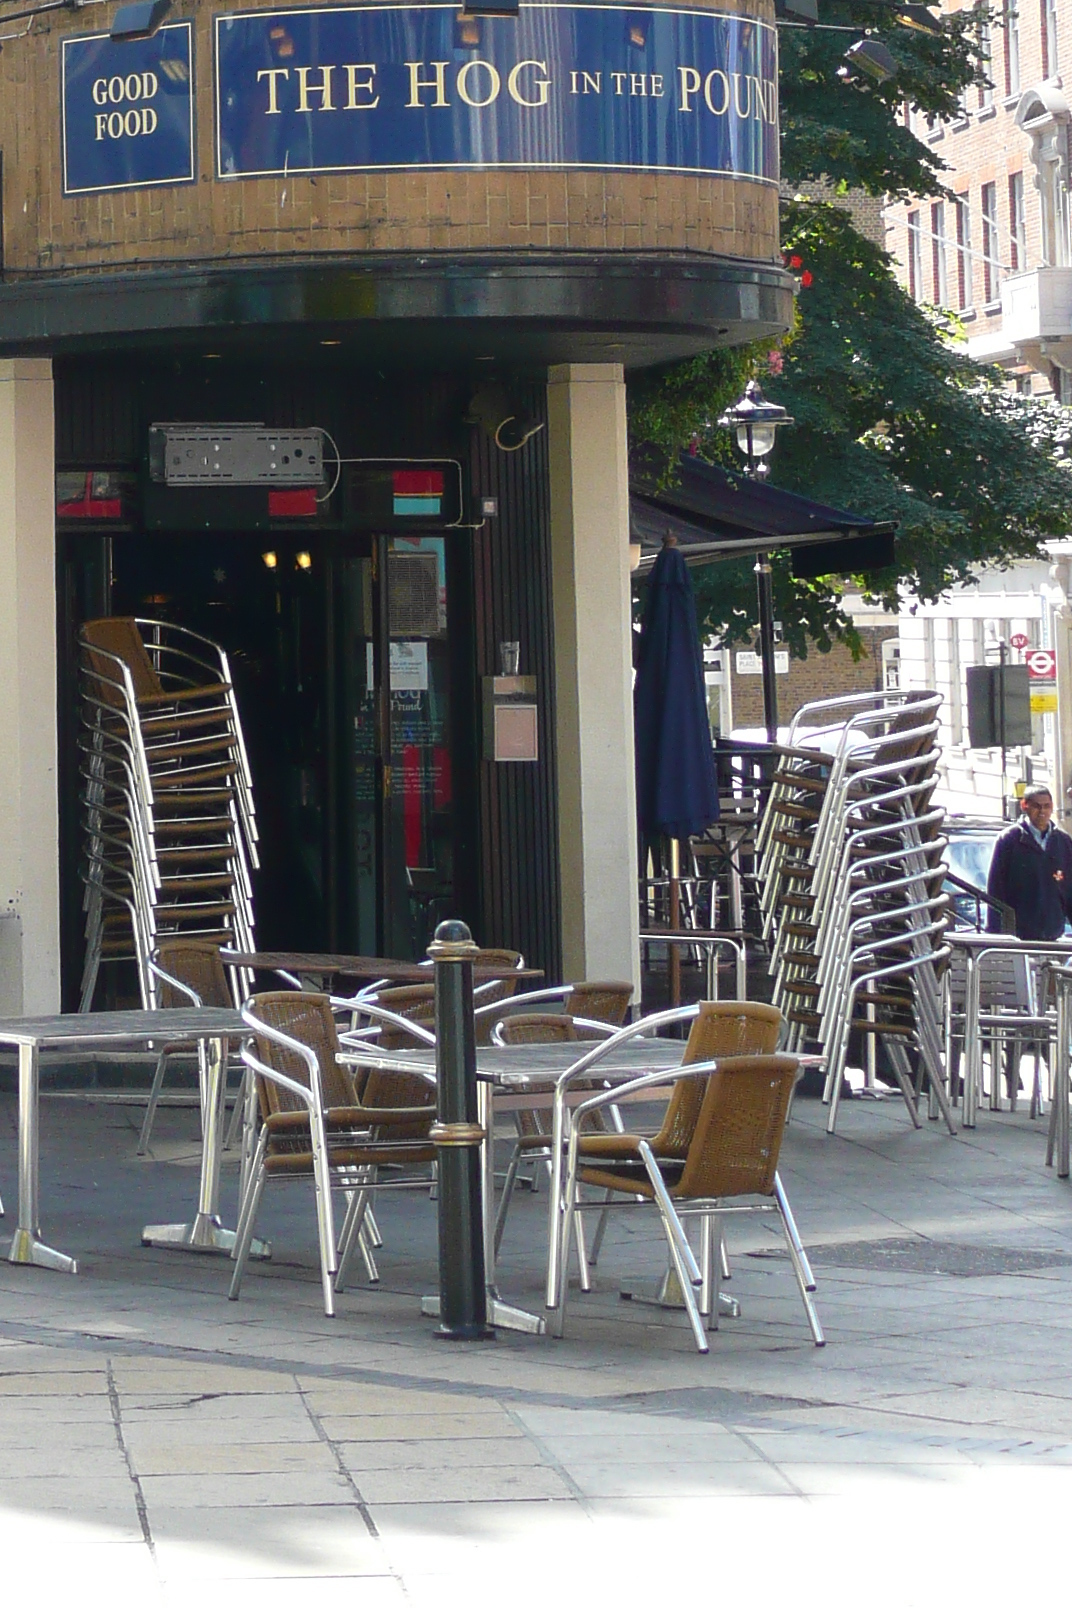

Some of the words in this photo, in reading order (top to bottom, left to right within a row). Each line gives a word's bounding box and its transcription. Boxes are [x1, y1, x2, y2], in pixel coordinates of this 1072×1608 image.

[92, 71, 159, 106] GOOD
[257, 62, 379, 116] THE
[404, 59, 552, 110] HOG
[569, 70, 602, 95] IN
[610, 72, 665, 98] THE
[677, 66, 778, 125] POUND
[94, 107, 159, 142] FOOD
